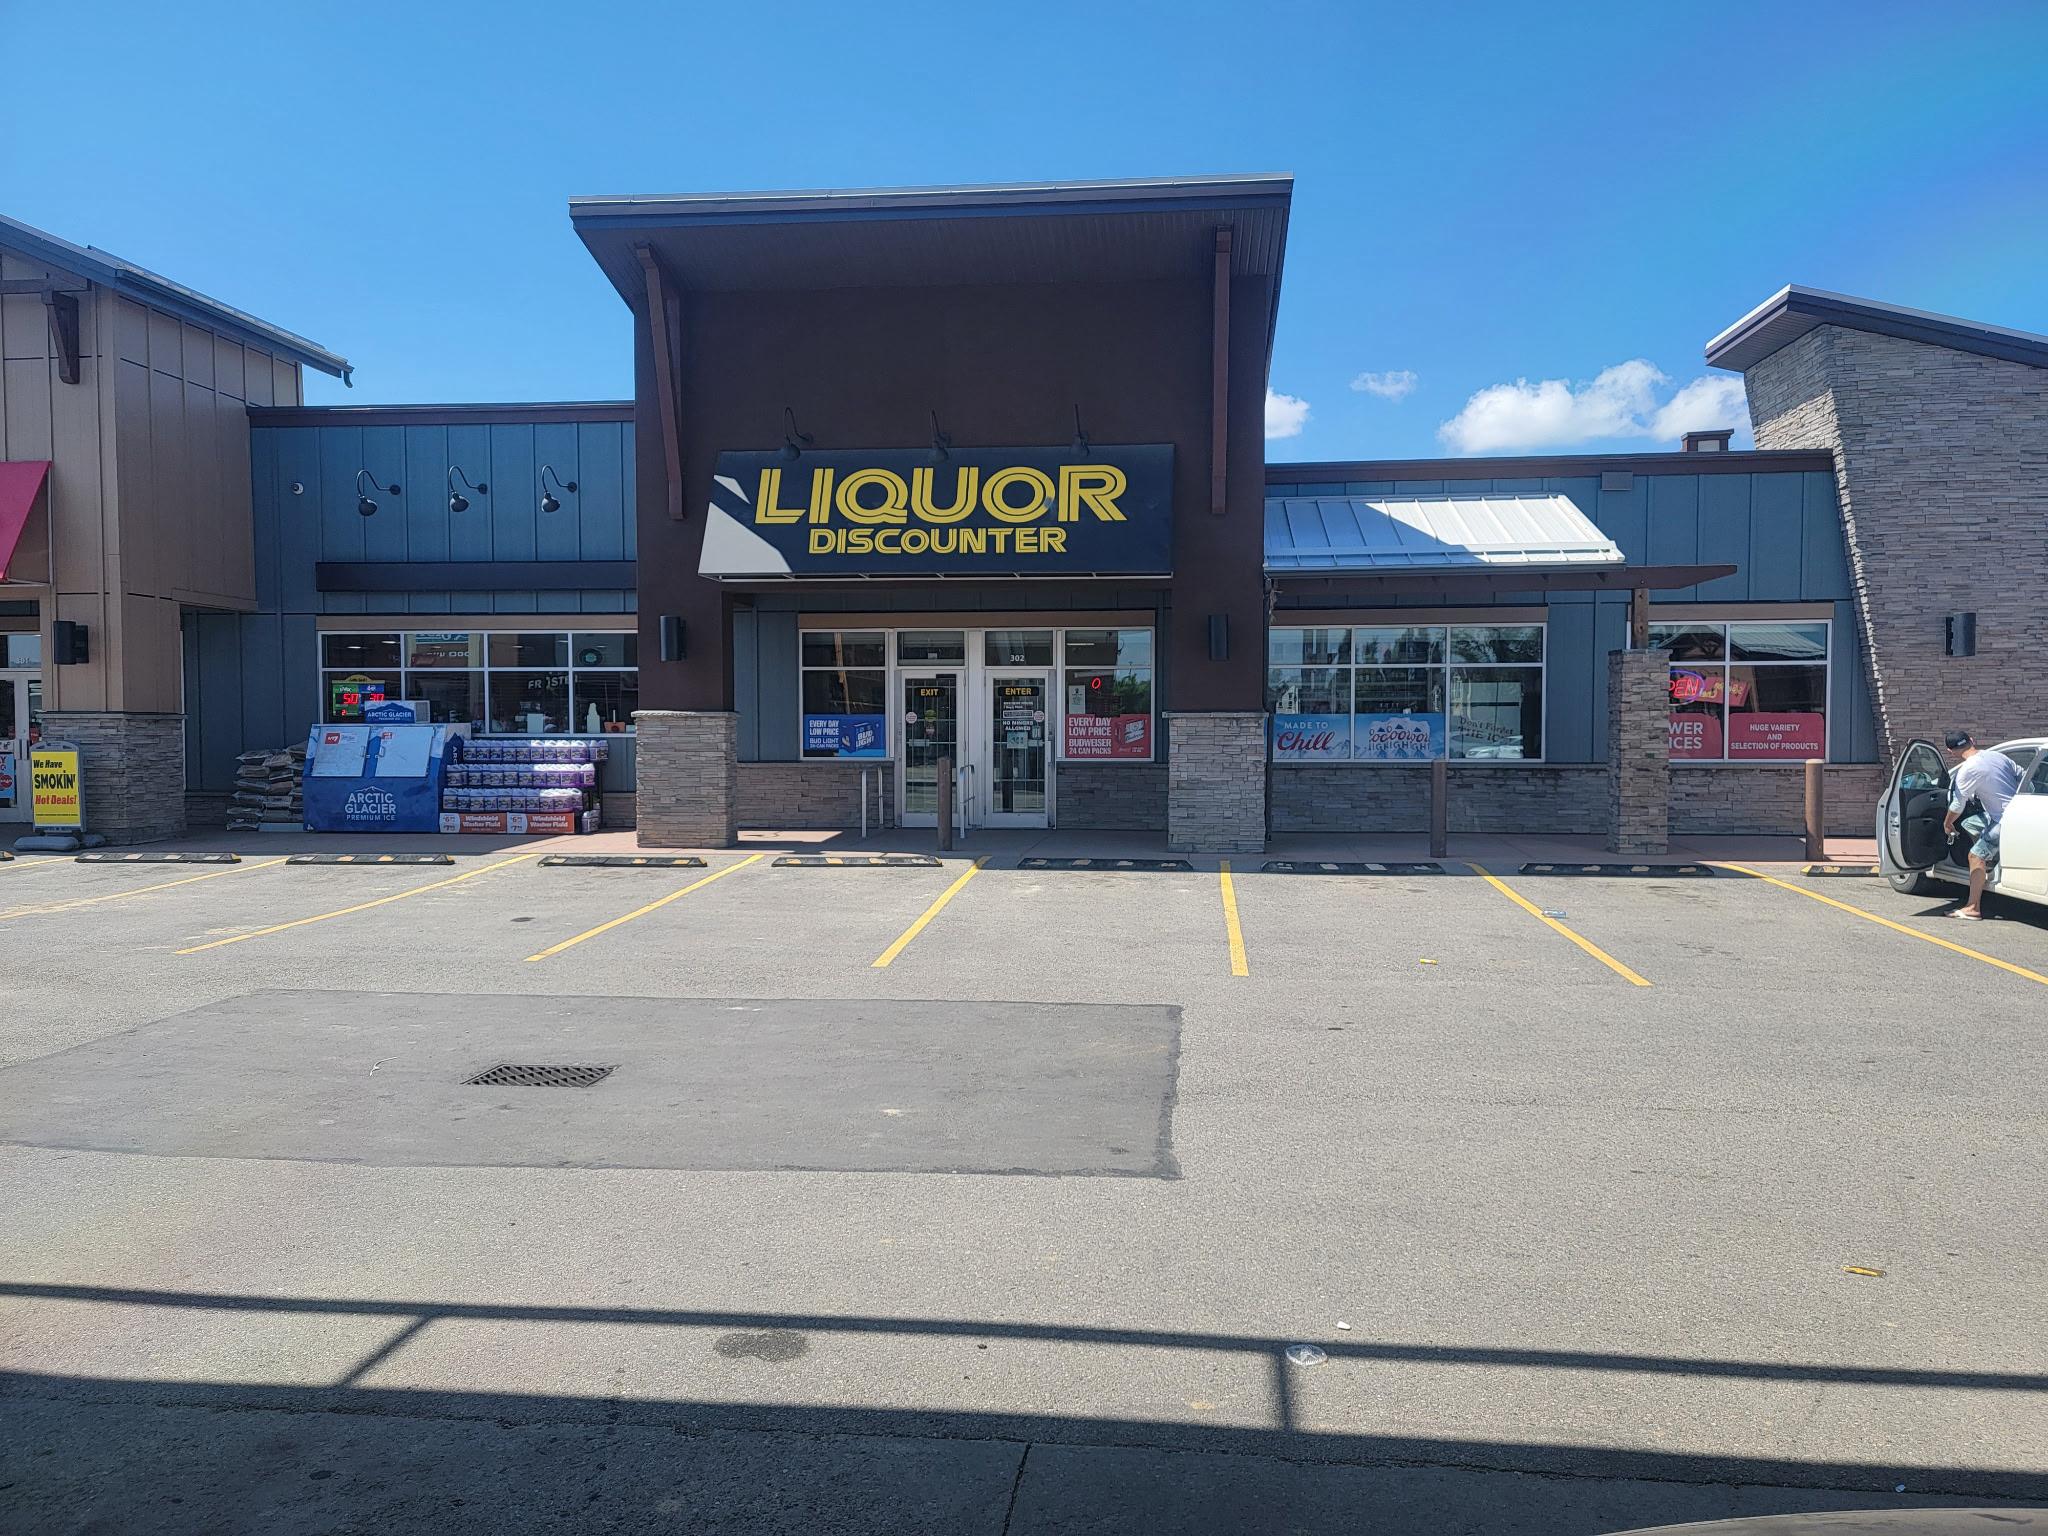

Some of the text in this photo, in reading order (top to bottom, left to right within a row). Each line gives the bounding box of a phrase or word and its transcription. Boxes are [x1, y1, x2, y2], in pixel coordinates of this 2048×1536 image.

[755, 464, 1128, 524] LIQUOR
[808, 526, 1067, 554] DISCOUNTER
[920, 688, 939, 696] EXIT
[1669, 677, 1699, 697] PEN
[809, 719, 840, 728] EVERY DAY
[1068, 717, 1112, 727] EVERY DAY
[1284, 721, 1329, 729] MADE TO
[1749, 723, 1800, 731] HUGE VARIETY
[809, 728, 839, 736] LOW PRICE
[1068, 727, 1112, 736] LOW PRICE
[1668, 721, 1704, 735] WER
[1277, 731, 1335, 751] Chill
[1766, 733, 1782, 741] AND
[1068, 738, 1112, 747] BUDWEISER
[1668, 736, 1703, 750] ICES
[1730, 742, 1819, 750] SELECTION OF PRODUCTS
[1068, 747, 1112, 755] 24 CAN PACKS
[33, 759, 63, 769] We Have
[34, 769, 76, 790] SMOKIN'
[35, 794, 77, 805] Hot Deals!
[347, 792, 394, 804] ARCTIC
[344, 803, 397, 814] GLACIER
